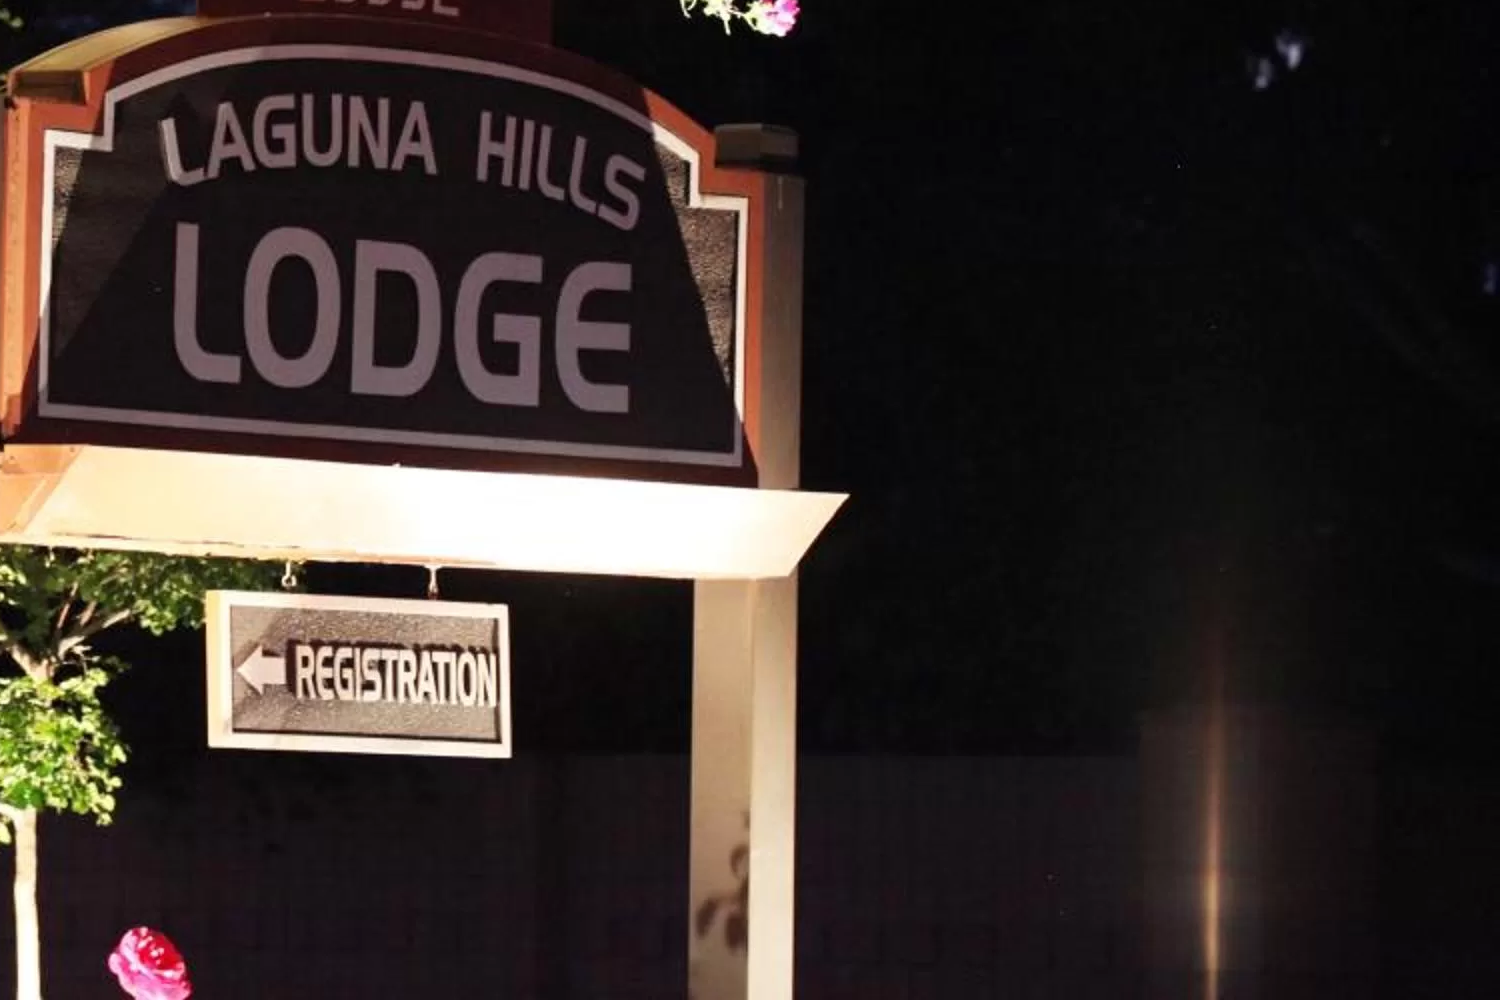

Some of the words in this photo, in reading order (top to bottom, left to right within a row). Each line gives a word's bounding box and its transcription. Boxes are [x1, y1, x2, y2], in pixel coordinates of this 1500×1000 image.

[160, 93, 438, 186] LAGUNA
[477, 111, 647, 232] HILLS
[173, 222, 632, 414] LODGE
[296, 645, 497, 708] REGISTRATION
